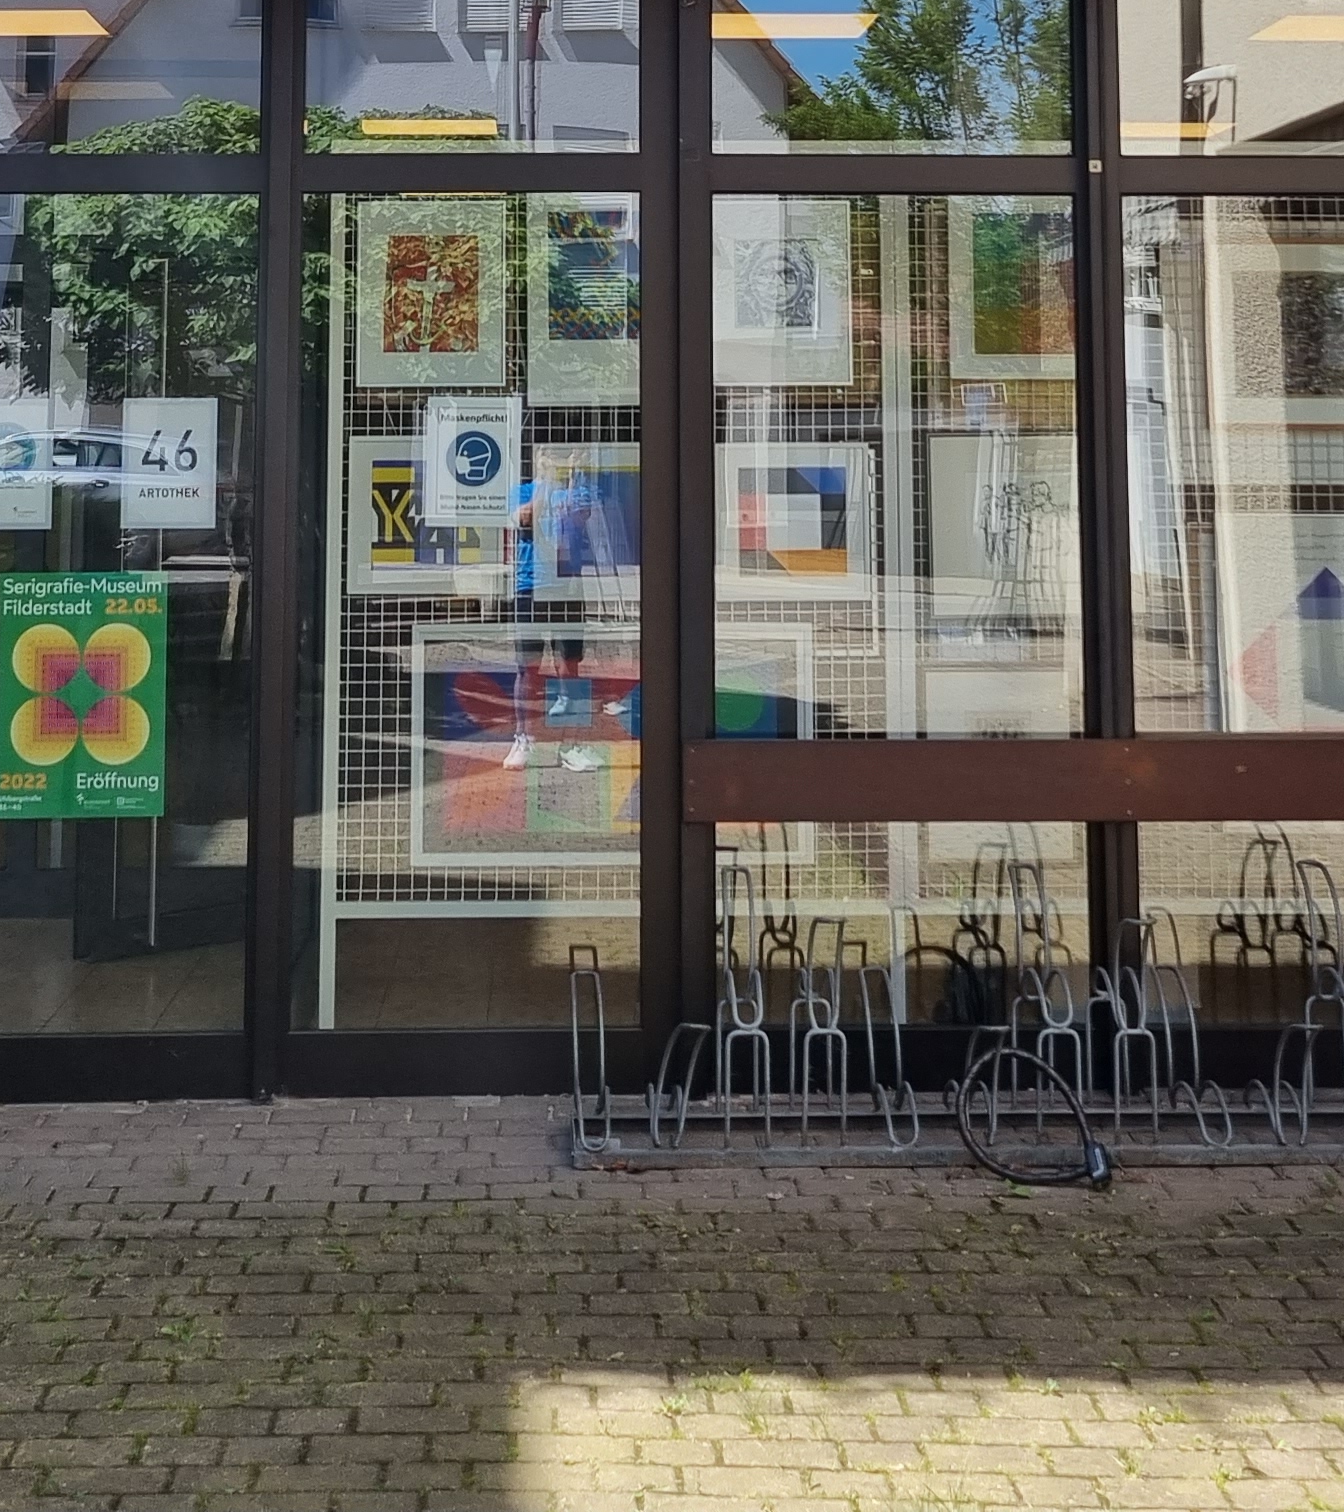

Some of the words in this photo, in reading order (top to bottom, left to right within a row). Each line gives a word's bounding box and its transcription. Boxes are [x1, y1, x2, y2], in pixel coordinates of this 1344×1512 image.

[440, 413, 508, 424] Maskenpflicht!
[141, 429, 198, 472] 46
[138, 487, 201, 499] ARTOTHEK
[2, 577, 162, 598] Serigrafie-Museum
[2, 599, 93, 616] Filderstadt
[105, 598, 164, 614] 22.05.
[0, 773, 48, 790] 2022
[76, 771, 159, 792] Eröffnung
